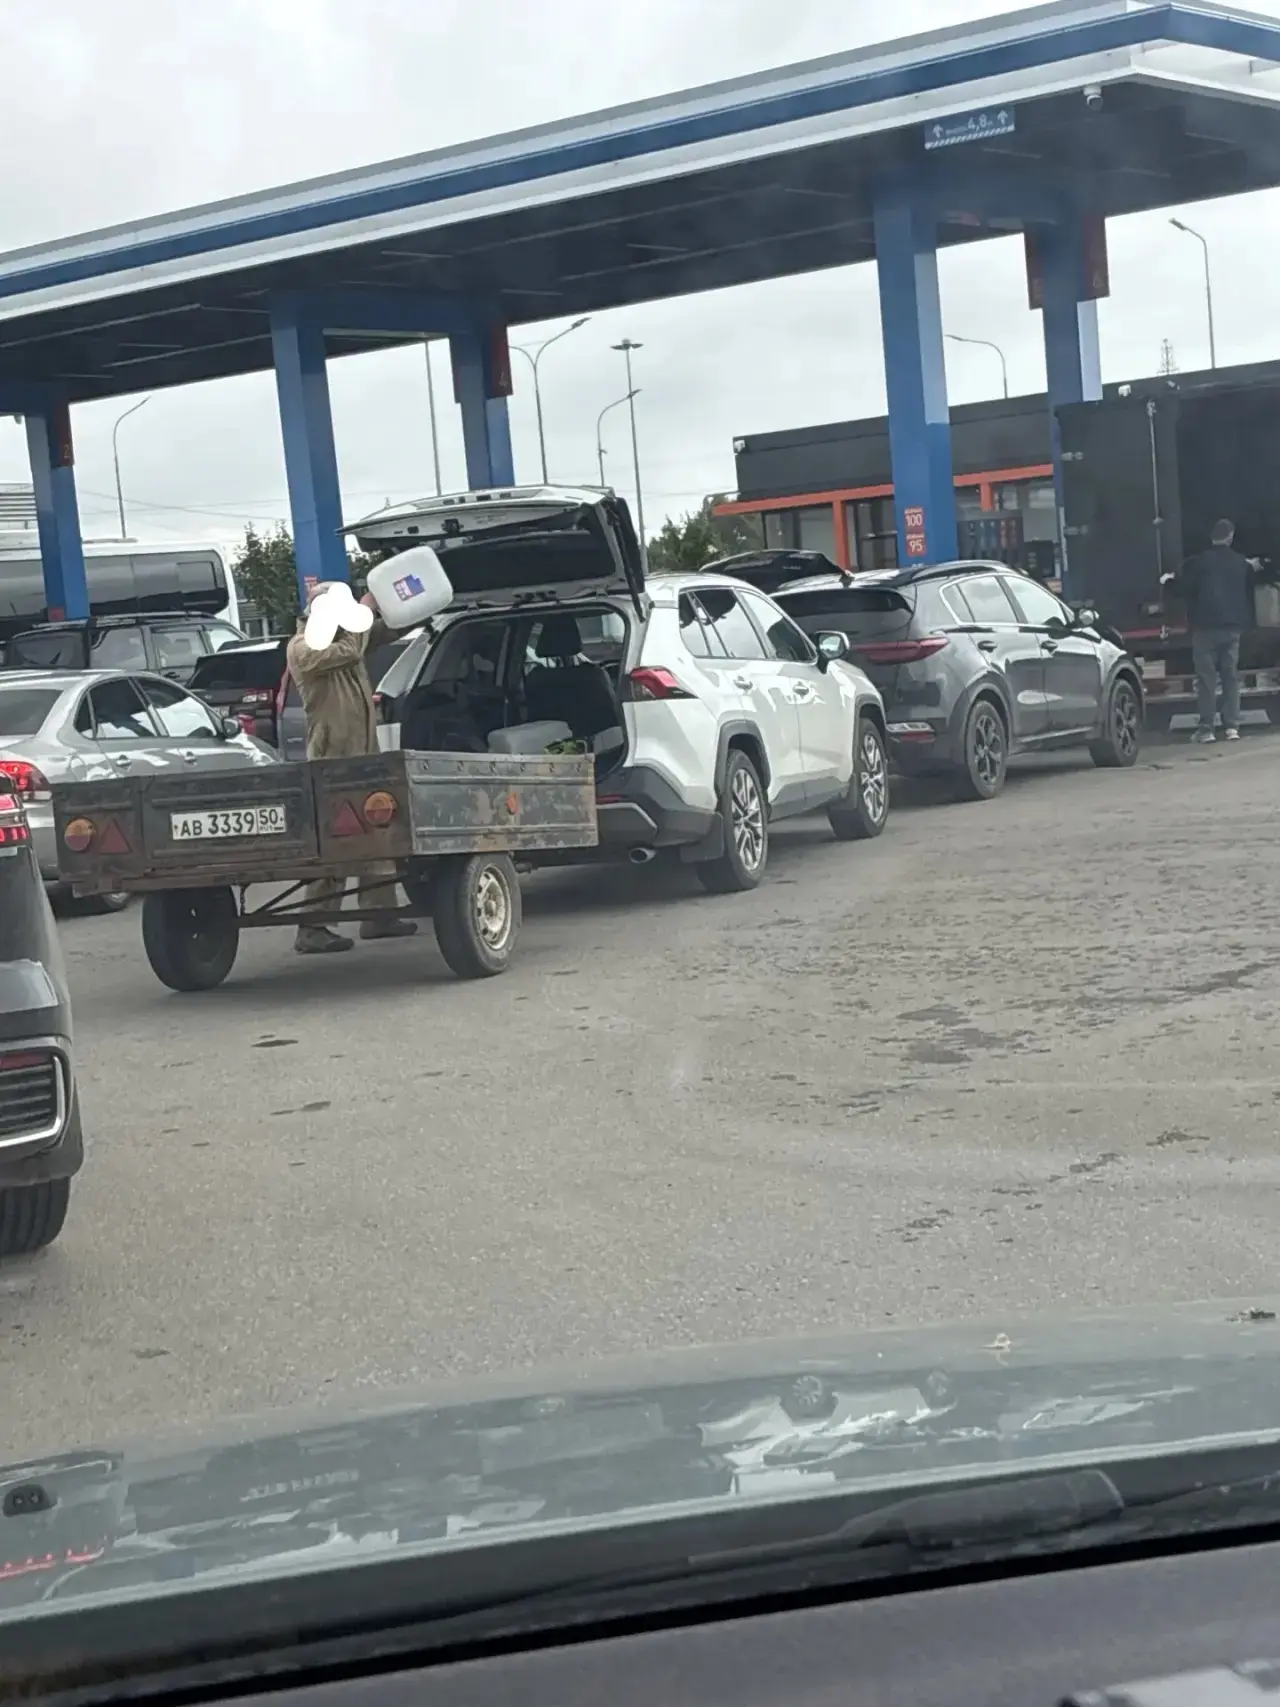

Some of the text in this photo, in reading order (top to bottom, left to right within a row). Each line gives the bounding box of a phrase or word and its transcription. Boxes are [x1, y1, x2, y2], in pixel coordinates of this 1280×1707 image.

[906, 513, 923, 527] 100
[909, 539, 923, 553] 95
[207, 811, 255, 835] 3339
[259, 808, 278, 825] 50
